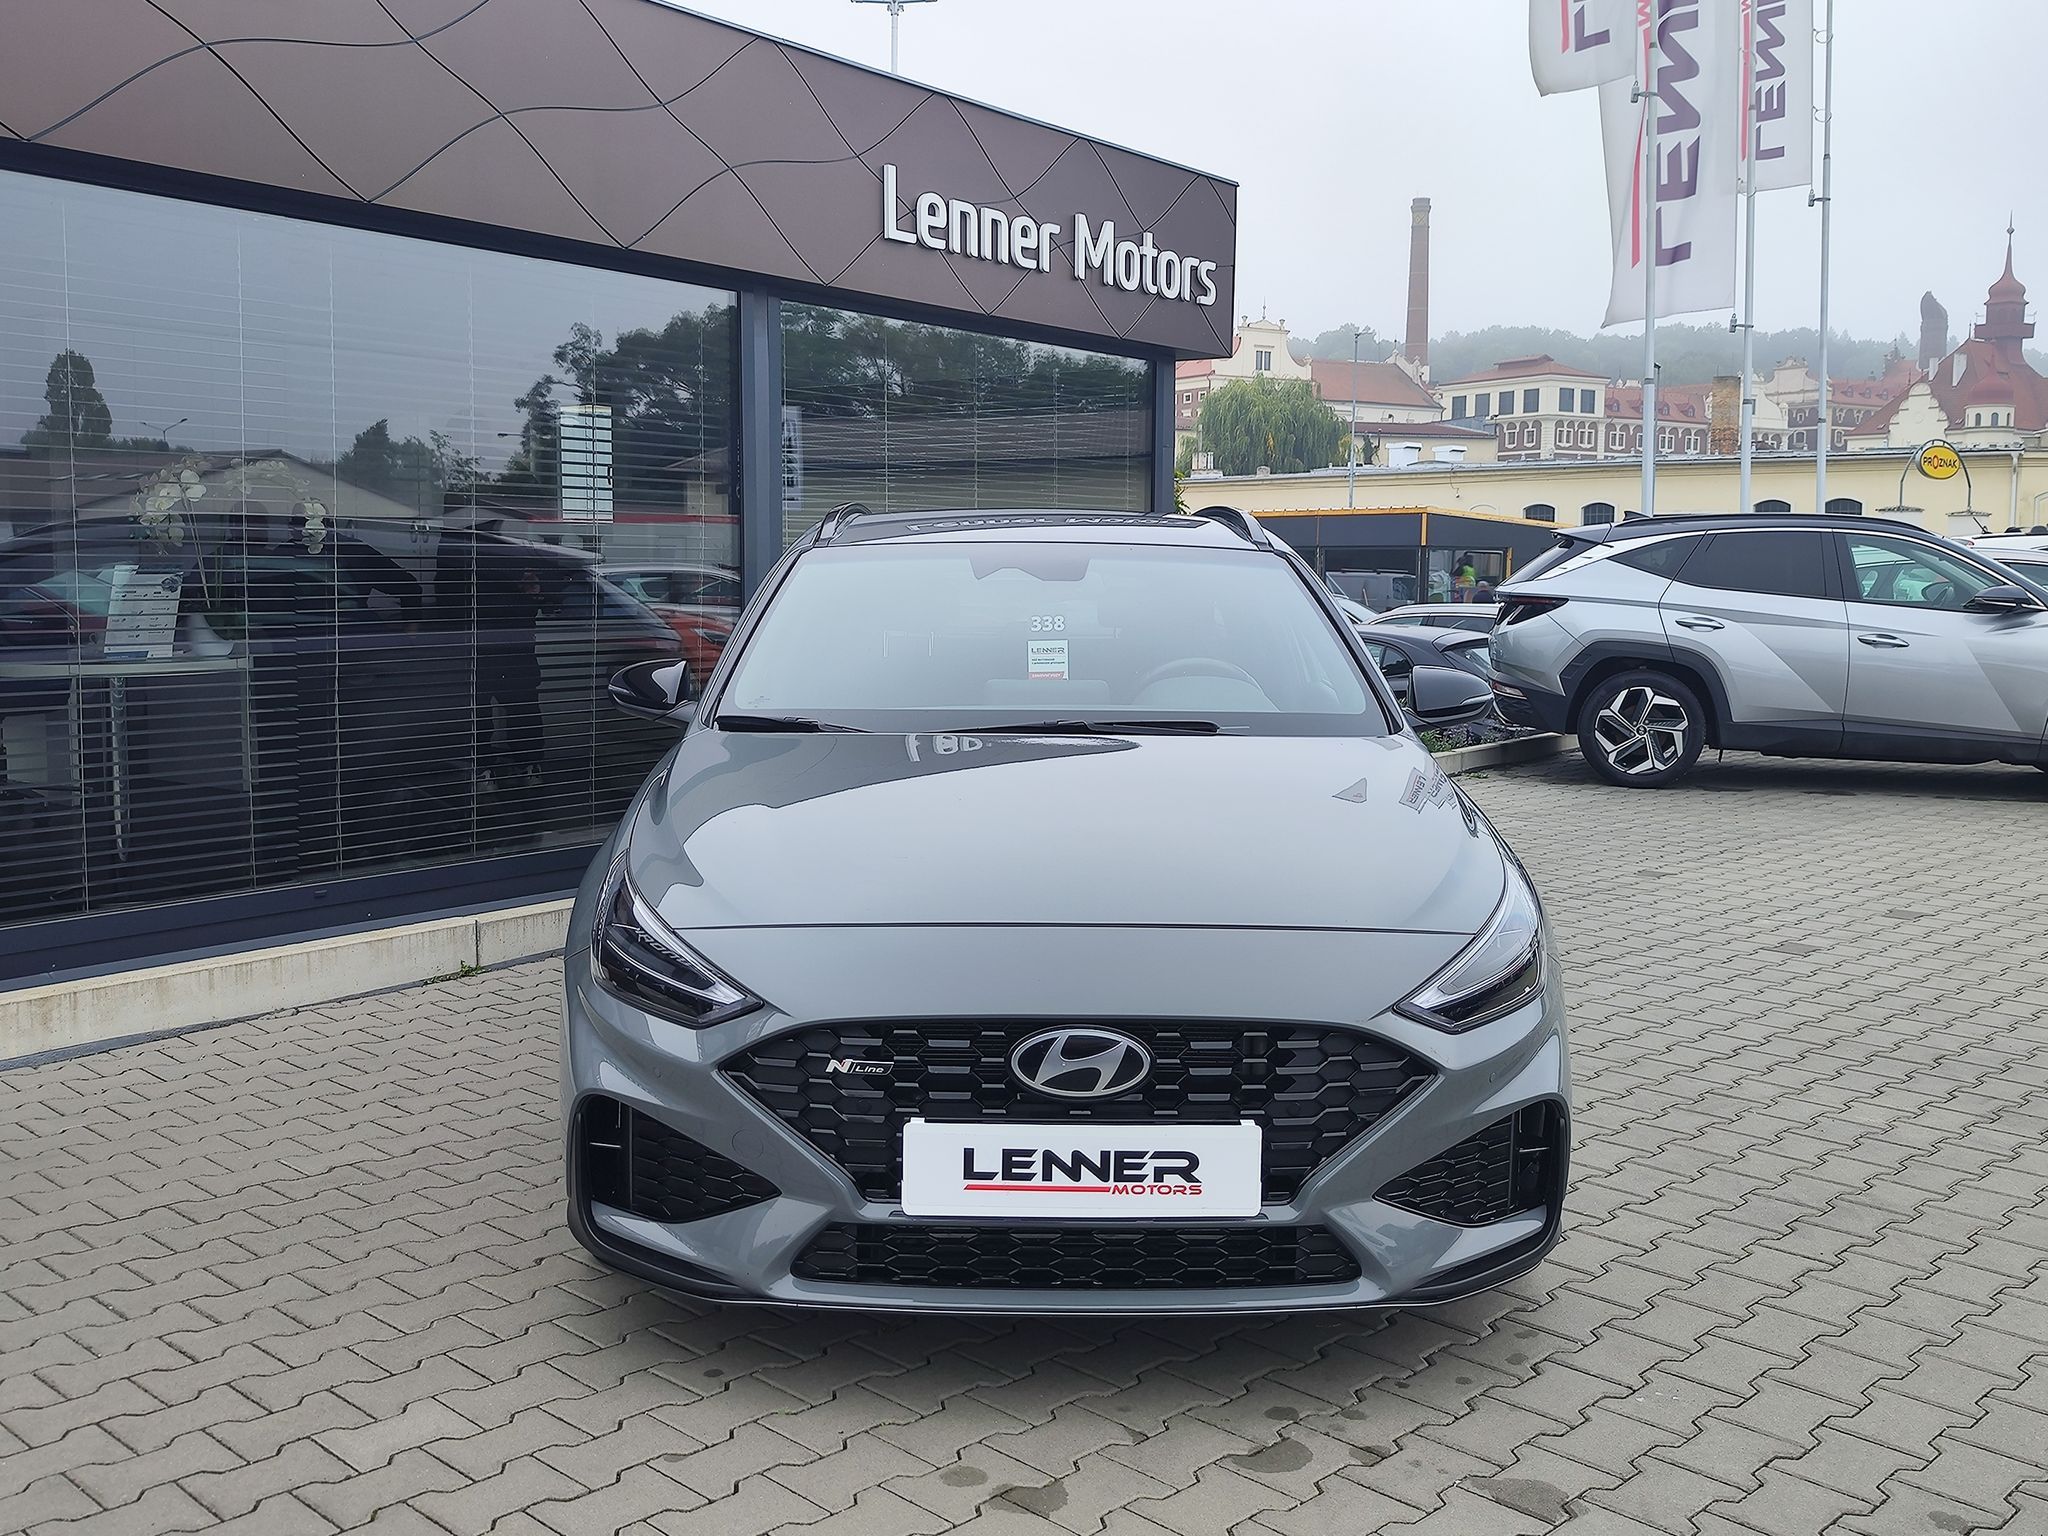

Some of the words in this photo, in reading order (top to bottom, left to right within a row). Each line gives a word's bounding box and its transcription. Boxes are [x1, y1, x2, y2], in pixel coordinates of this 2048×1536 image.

[882, 162, 1060, 273] Lenner
[1074, 213, 1216, 306] Motors
[1923, 455, 1957, 469] PROZNAK
[1030, 615, 1065, 632] 338
[825, 1059, 852, 1073] N
[855, 1065, 885, 1073] Line
[963, 1147, 1202, 1183] LENNER
[1111, 1183, 1203, 1195] MOTORS
